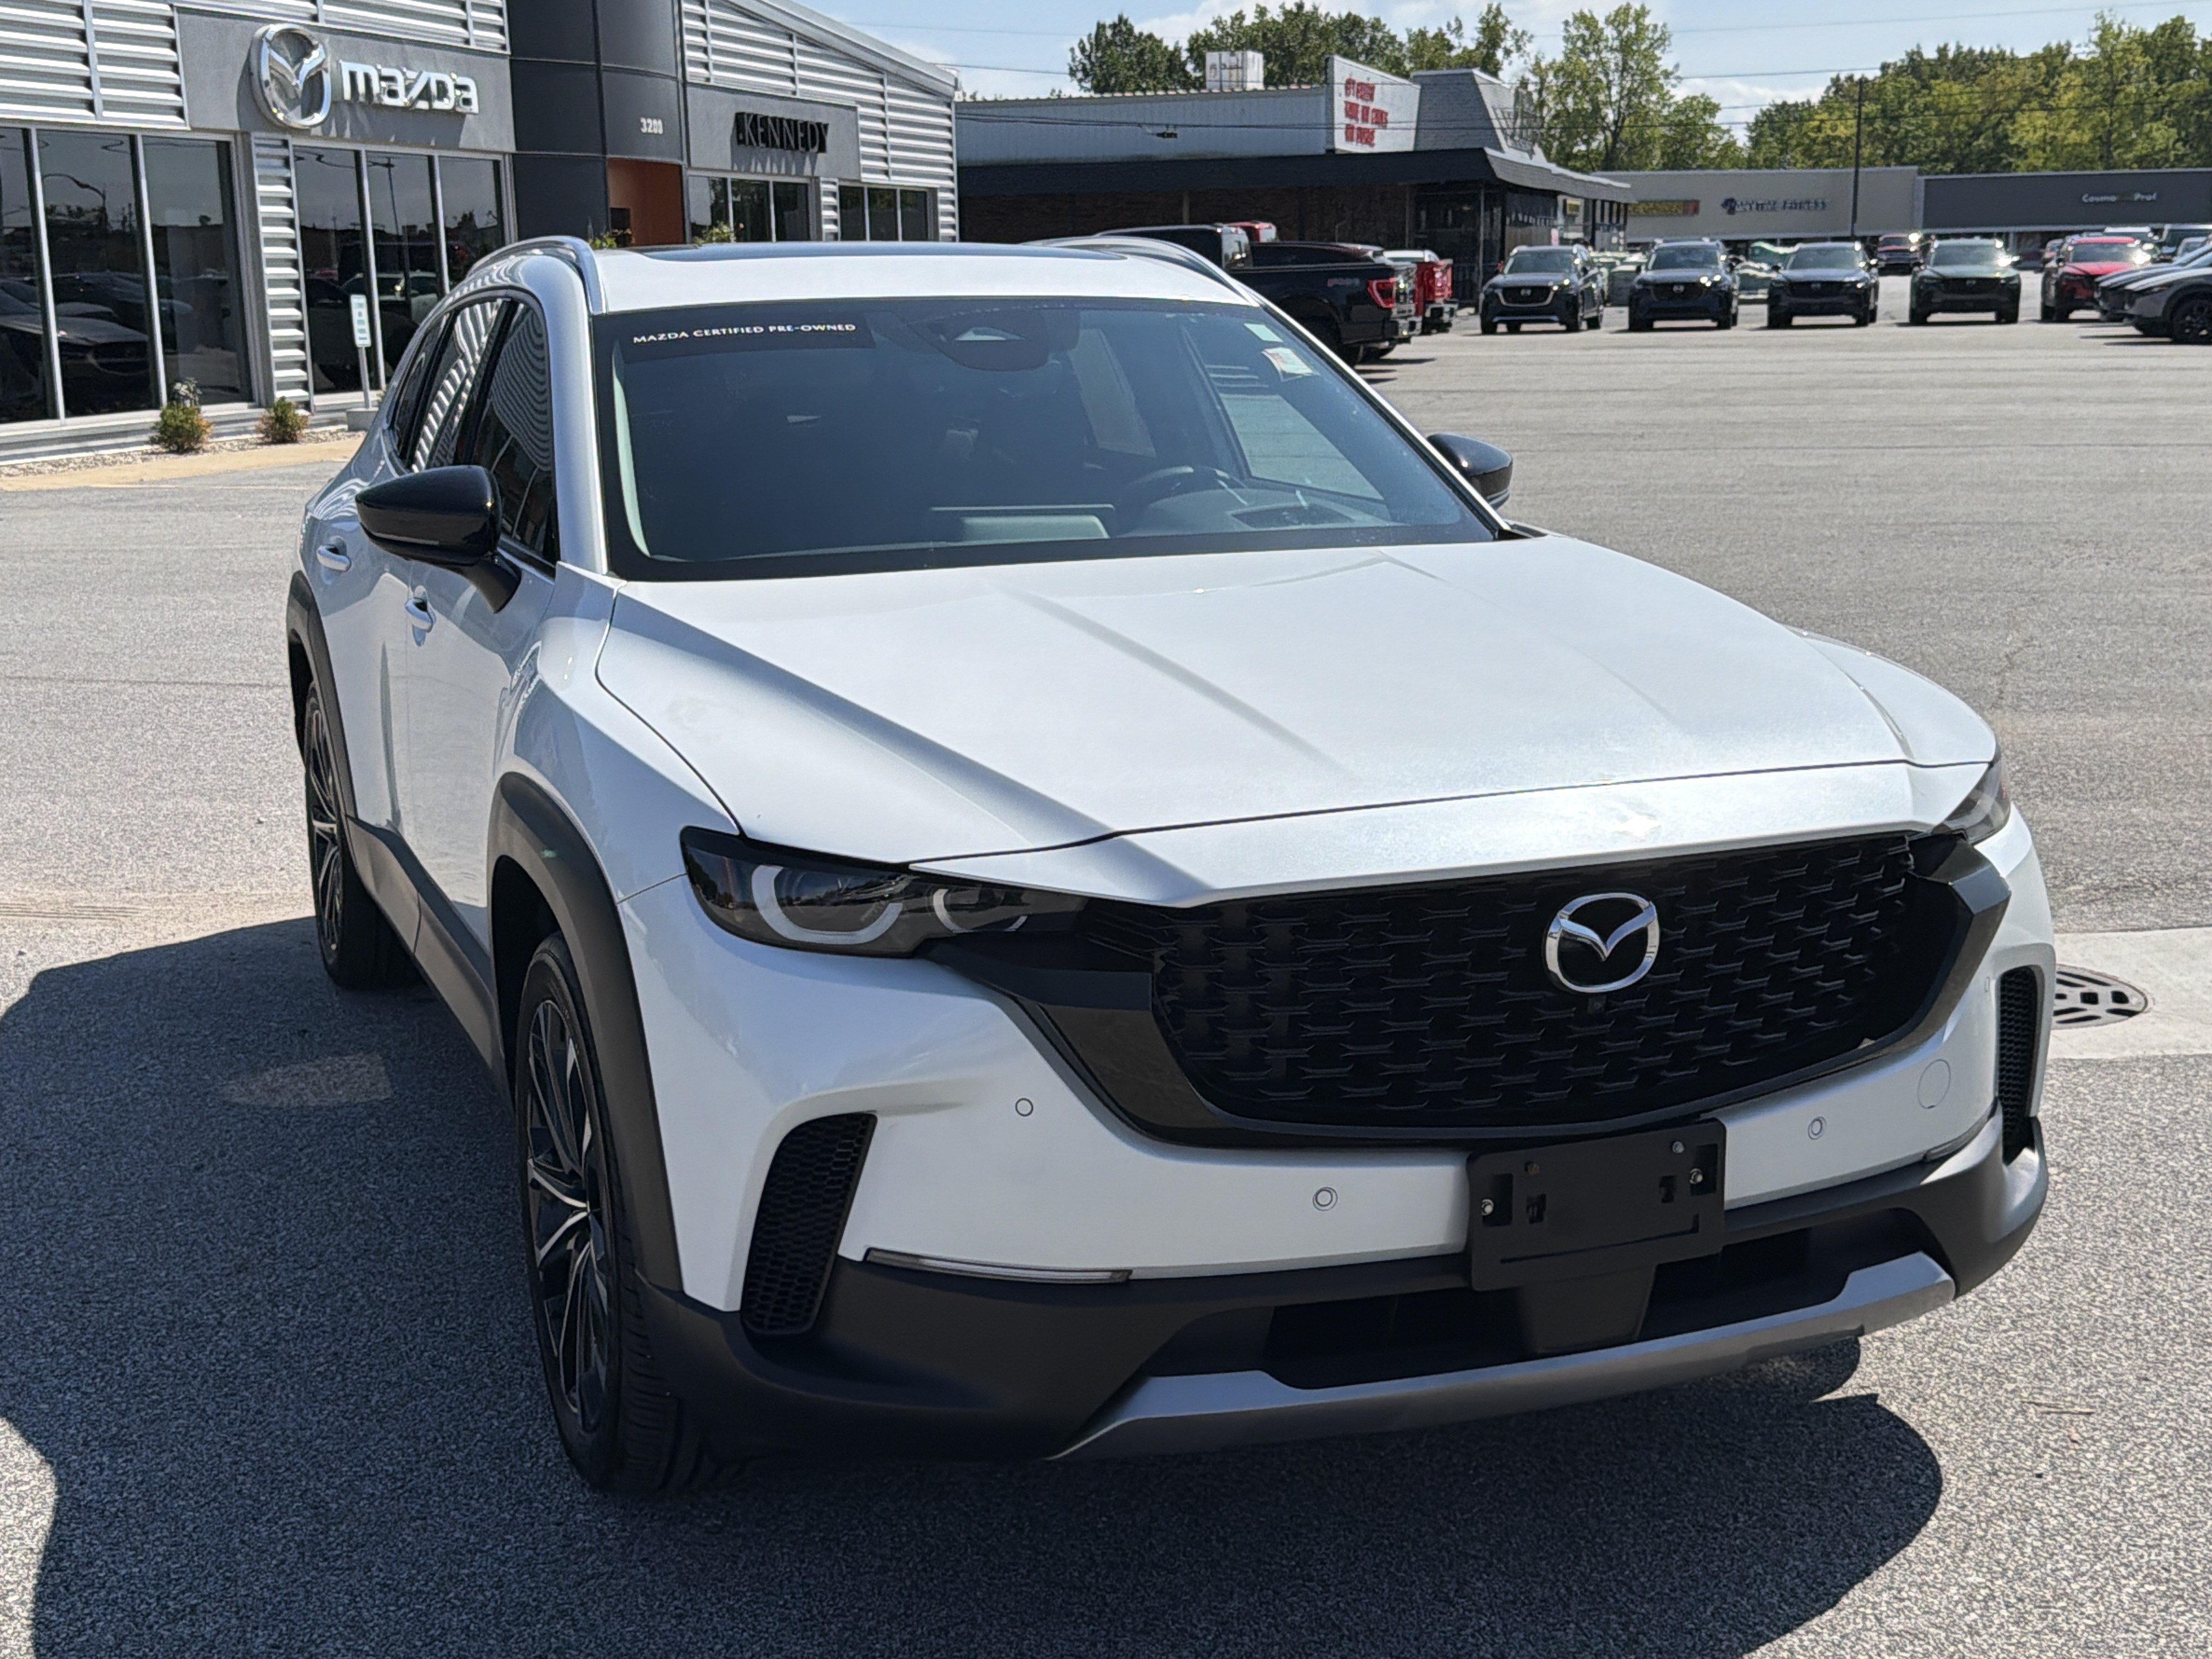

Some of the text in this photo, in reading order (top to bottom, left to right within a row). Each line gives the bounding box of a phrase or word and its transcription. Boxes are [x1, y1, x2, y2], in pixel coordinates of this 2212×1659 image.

[338, 59, 479, 114] mazda
[738, 112, 830, 153] KENNEDY
[633, 323, 856, 344] MAZDA CERTIFIED PRE-OWNED
